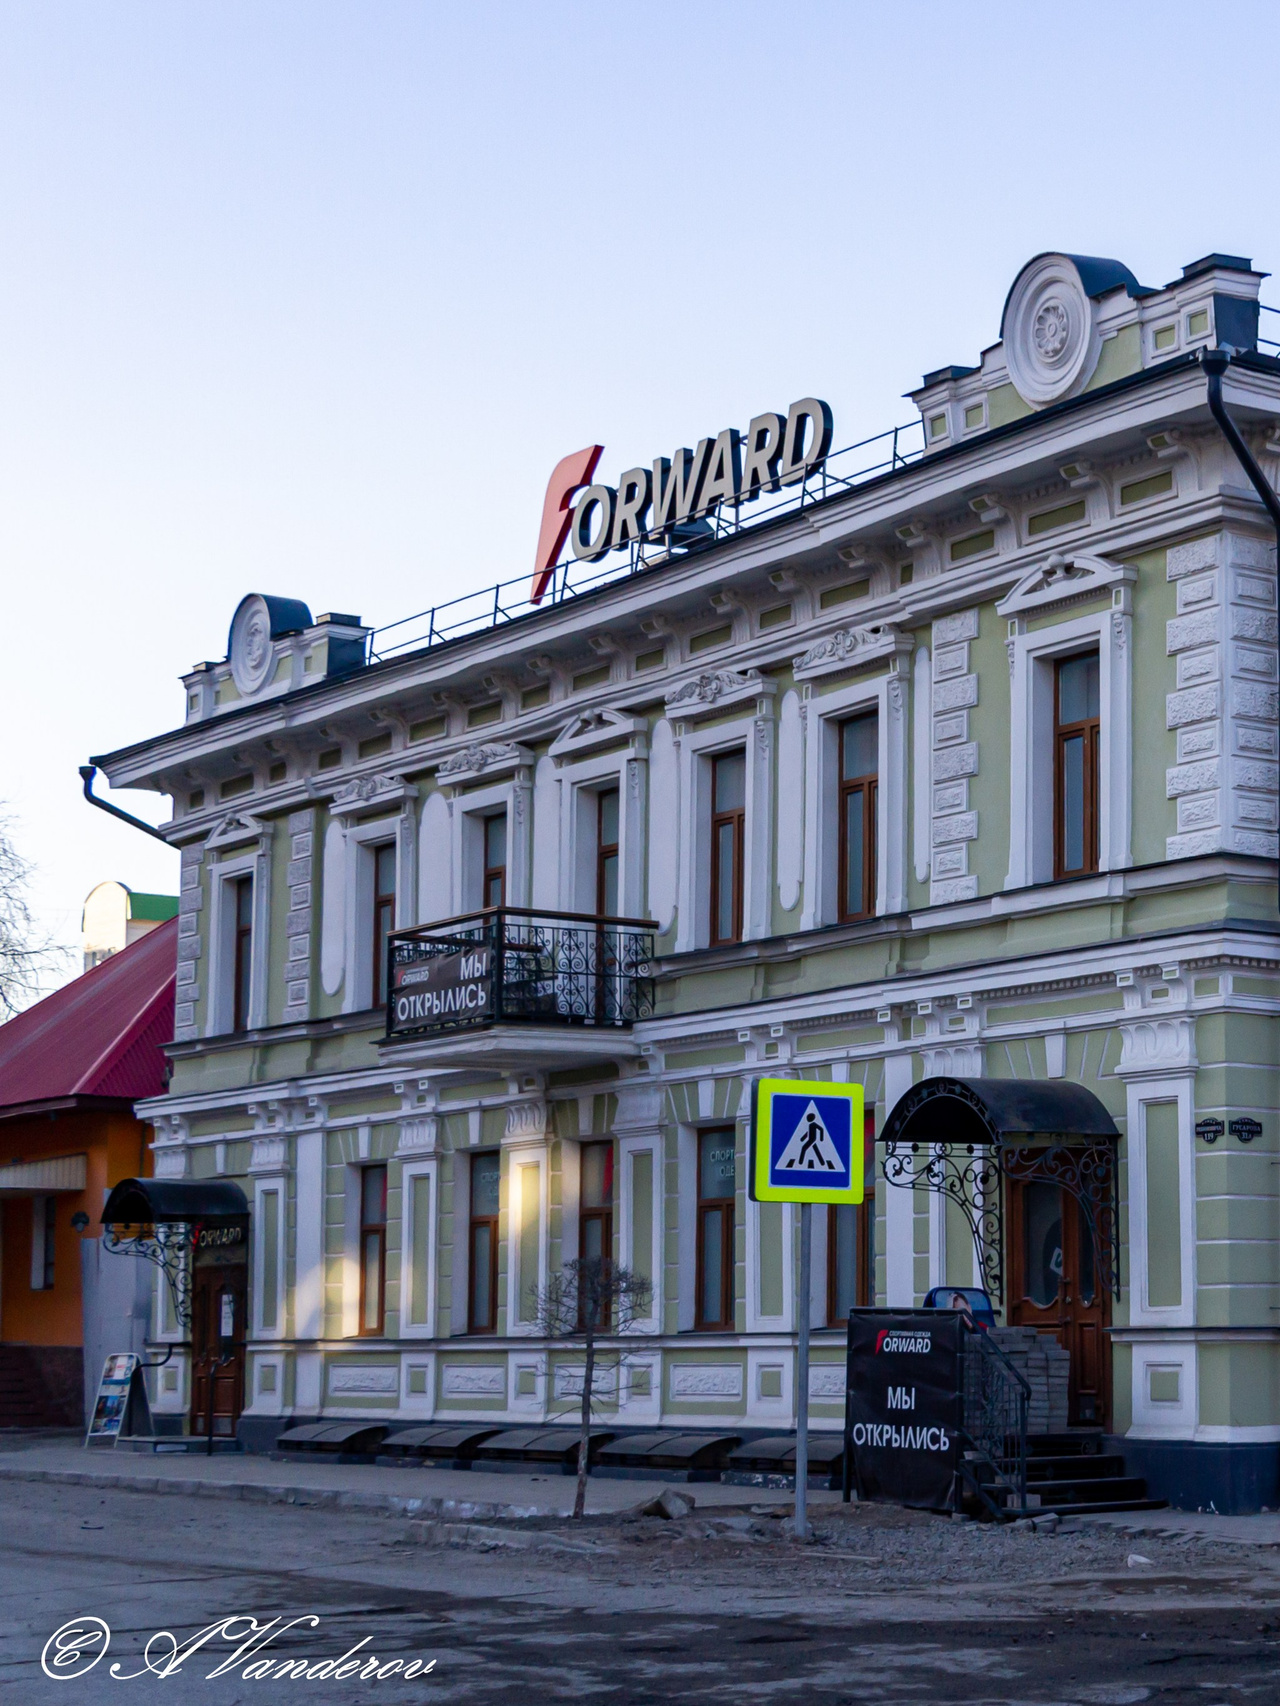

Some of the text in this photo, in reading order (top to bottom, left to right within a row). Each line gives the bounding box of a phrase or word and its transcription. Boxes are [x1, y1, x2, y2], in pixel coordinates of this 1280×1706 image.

[530, 397, 833, 606] FORWARD
[460, 953, 487, 980] МЫ
[397, 983, 486, 1021] ОТКРЫЛИСЬ
[875, 1329, 931, 1355] FORWARD
[888, 1386, 915, 1410] МЫ
[853, 1423, 949, 1451] ОТКРЫЛИСЬ
